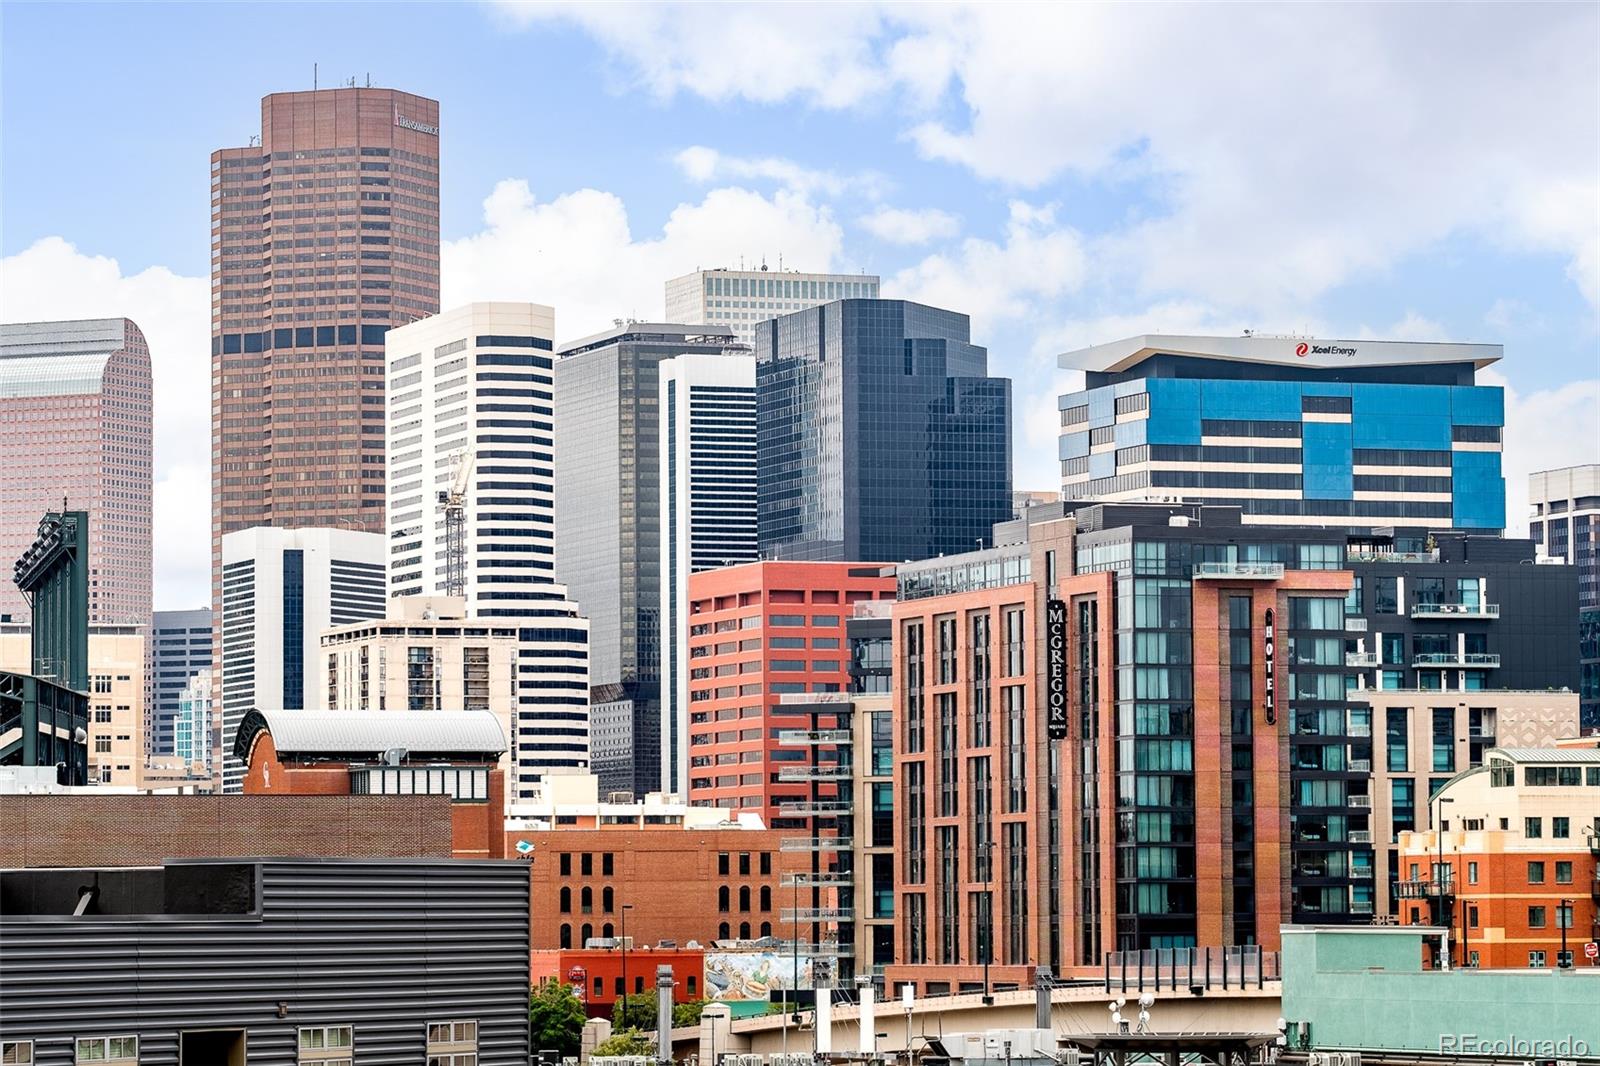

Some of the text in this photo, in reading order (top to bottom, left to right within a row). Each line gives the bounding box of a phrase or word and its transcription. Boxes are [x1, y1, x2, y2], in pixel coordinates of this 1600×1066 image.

[1311, 345, 1357, 356] Xcel Energy
[1048, 609, 1065, 721] MCGREGOR
[1265, 626, 1273, 707] HOTEL
